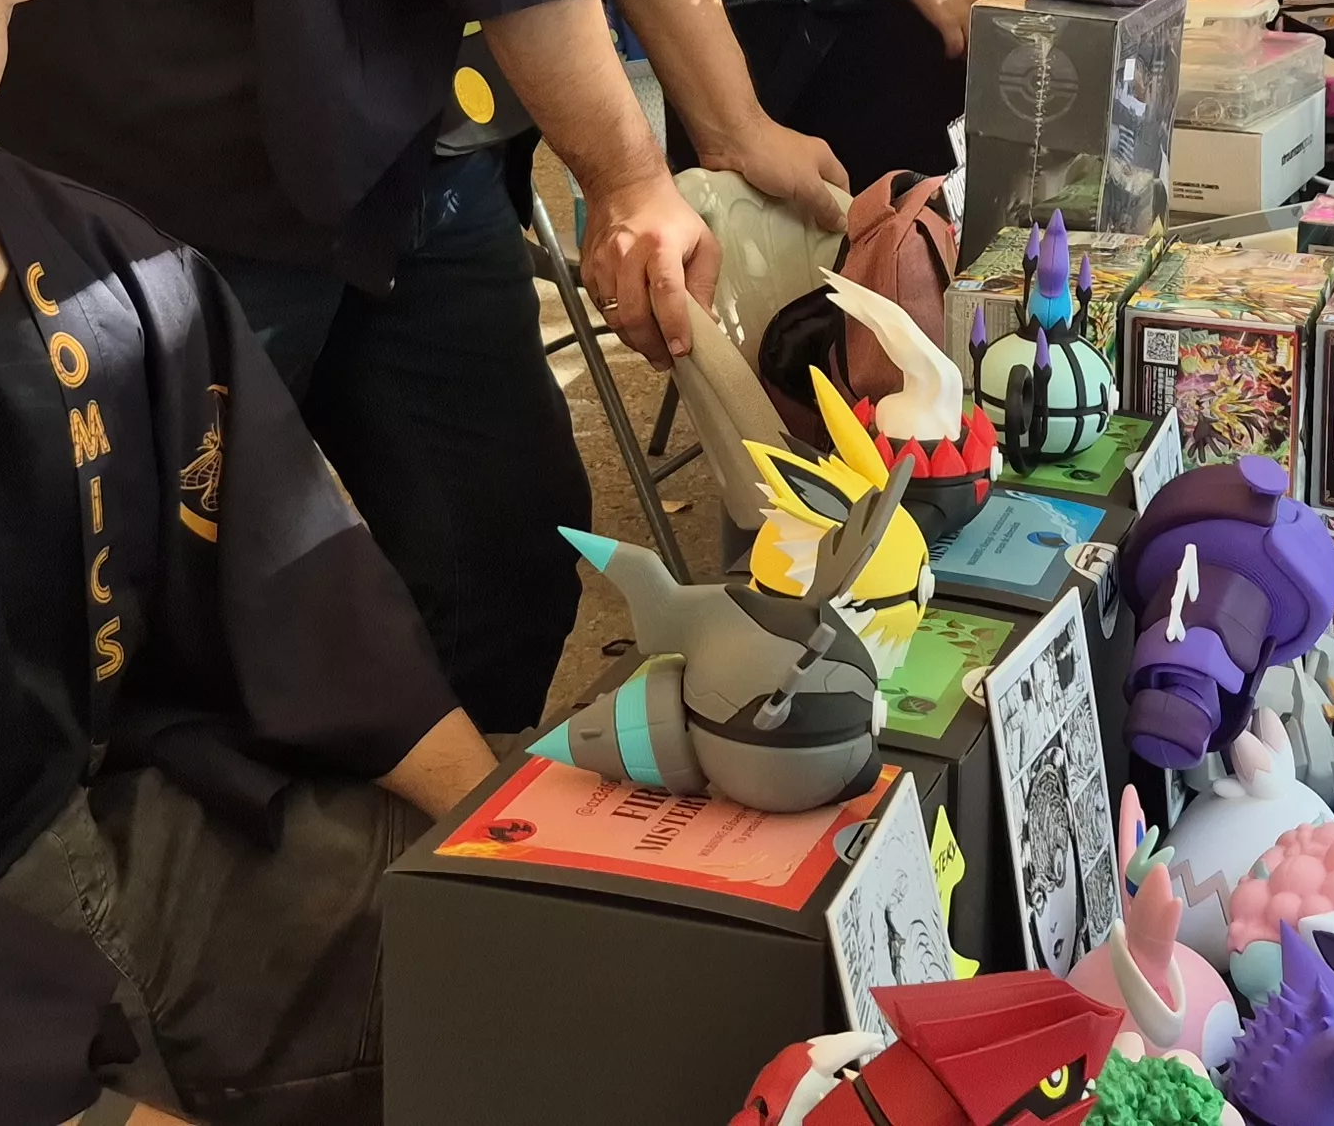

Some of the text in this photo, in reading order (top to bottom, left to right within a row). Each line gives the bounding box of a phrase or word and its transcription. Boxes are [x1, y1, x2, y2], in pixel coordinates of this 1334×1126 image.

[24, 261, 125, 682] COMICS
[610, 786, 673, 822] FIR
[633, 791, 713, 855] MISTER
